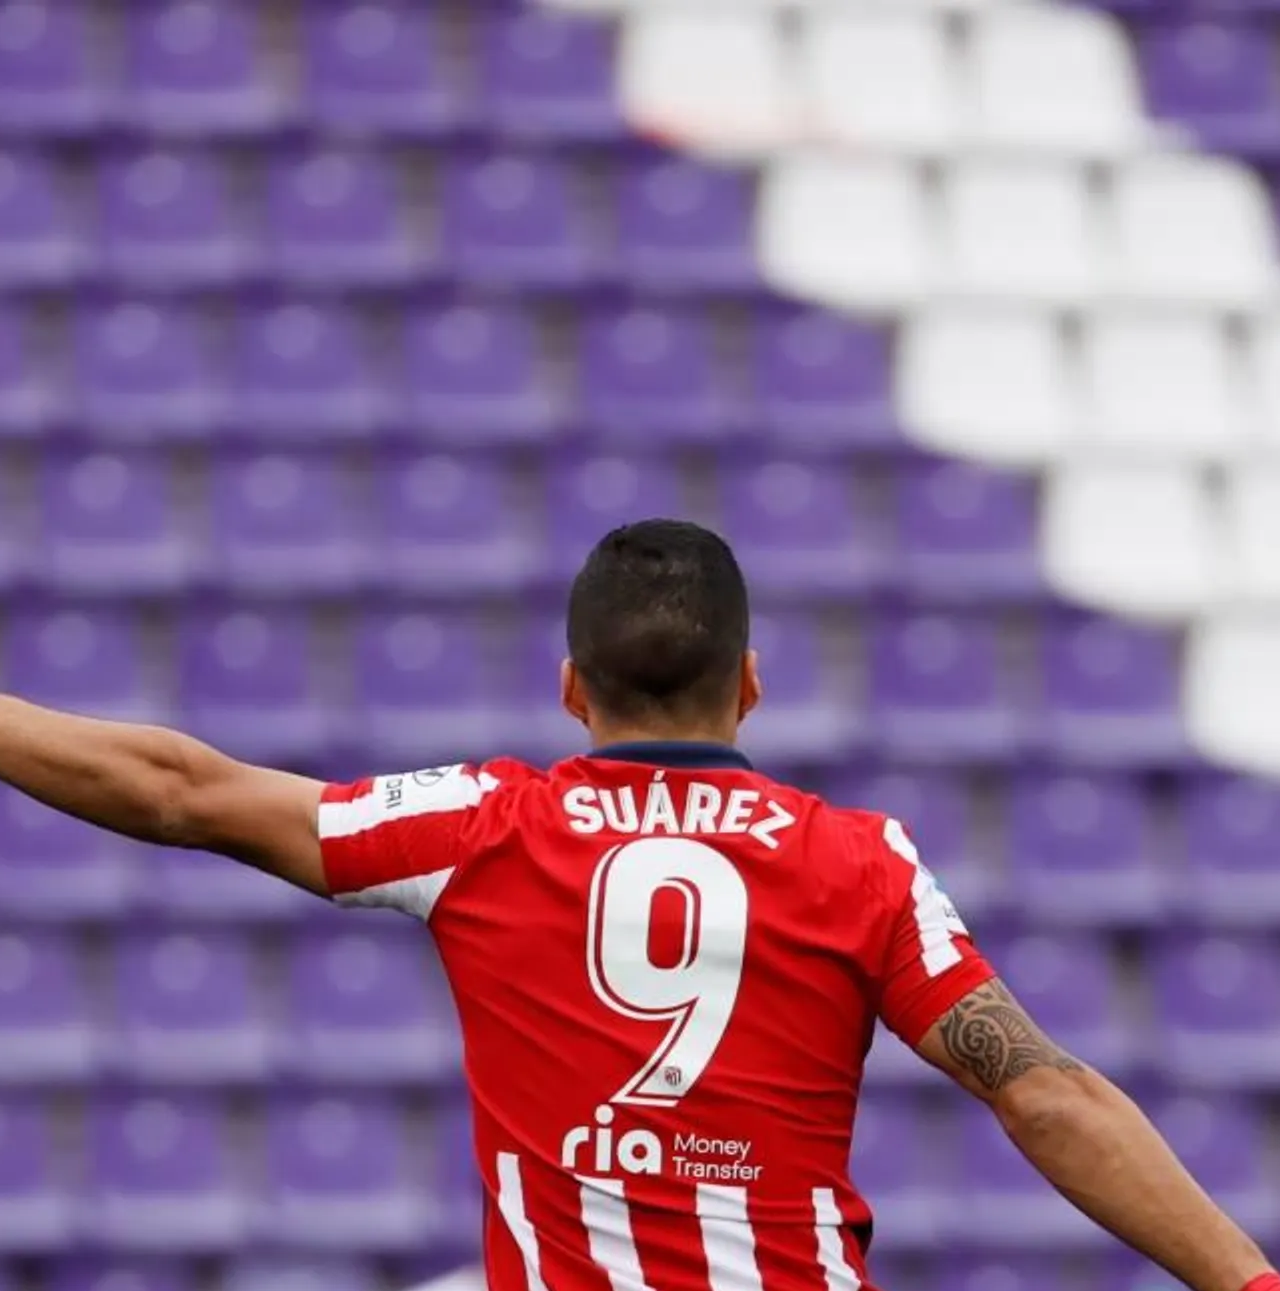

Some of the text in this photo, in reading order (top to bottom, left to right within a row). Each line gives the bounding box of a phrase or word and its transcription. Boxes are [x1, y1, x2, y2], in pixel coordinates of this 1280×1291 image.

[563, 769, 796, 850] SUÁREZ
[587, 836, 749, 1107] 9
[561, 1104, 663, 1175] ria
[672, 1156, 764, 1181] Transfer
[673, 1132, 752, 1162] Money
